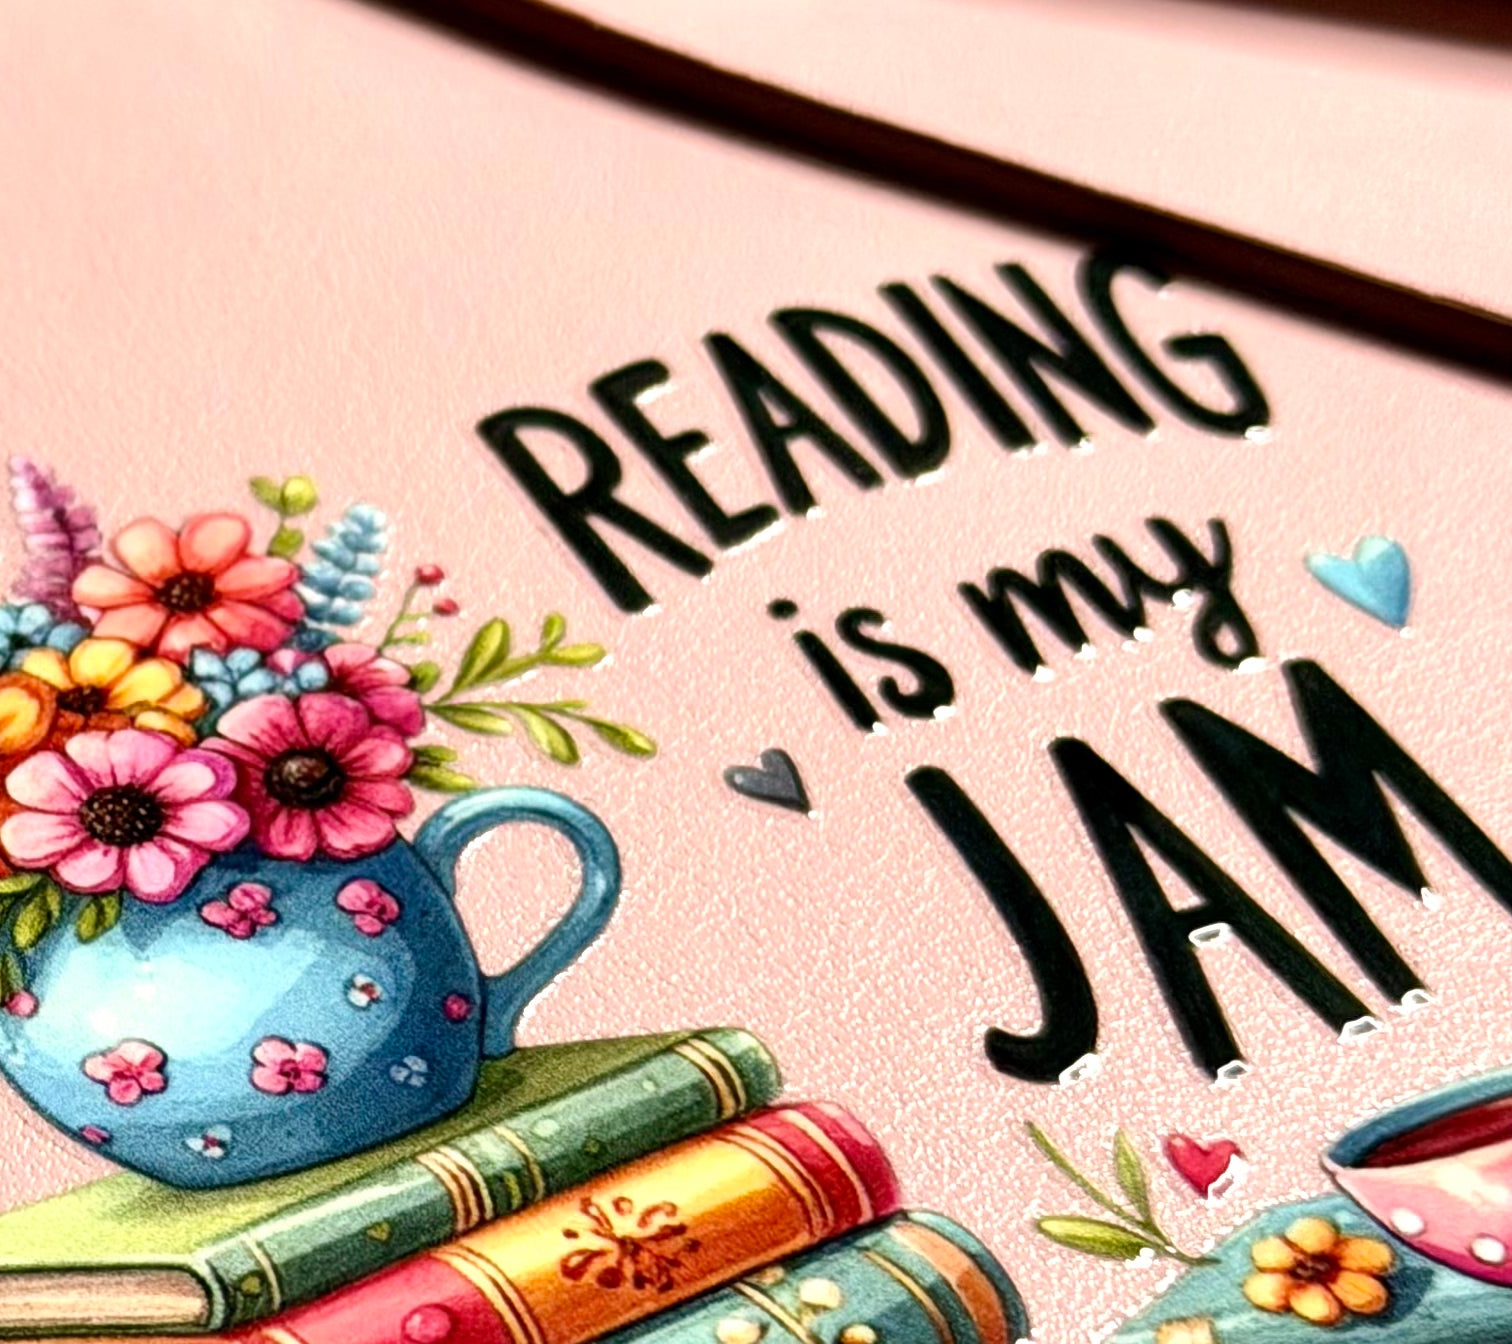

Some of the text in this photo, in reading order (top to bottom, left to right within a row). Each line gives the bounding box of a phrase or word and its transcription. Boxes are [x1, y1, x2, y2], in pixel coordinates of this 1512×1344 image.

[476, 240, 1270, 615] READING
[767, 516, 1264, 732] is my
[903, 658, 1512, 1084] JAM
